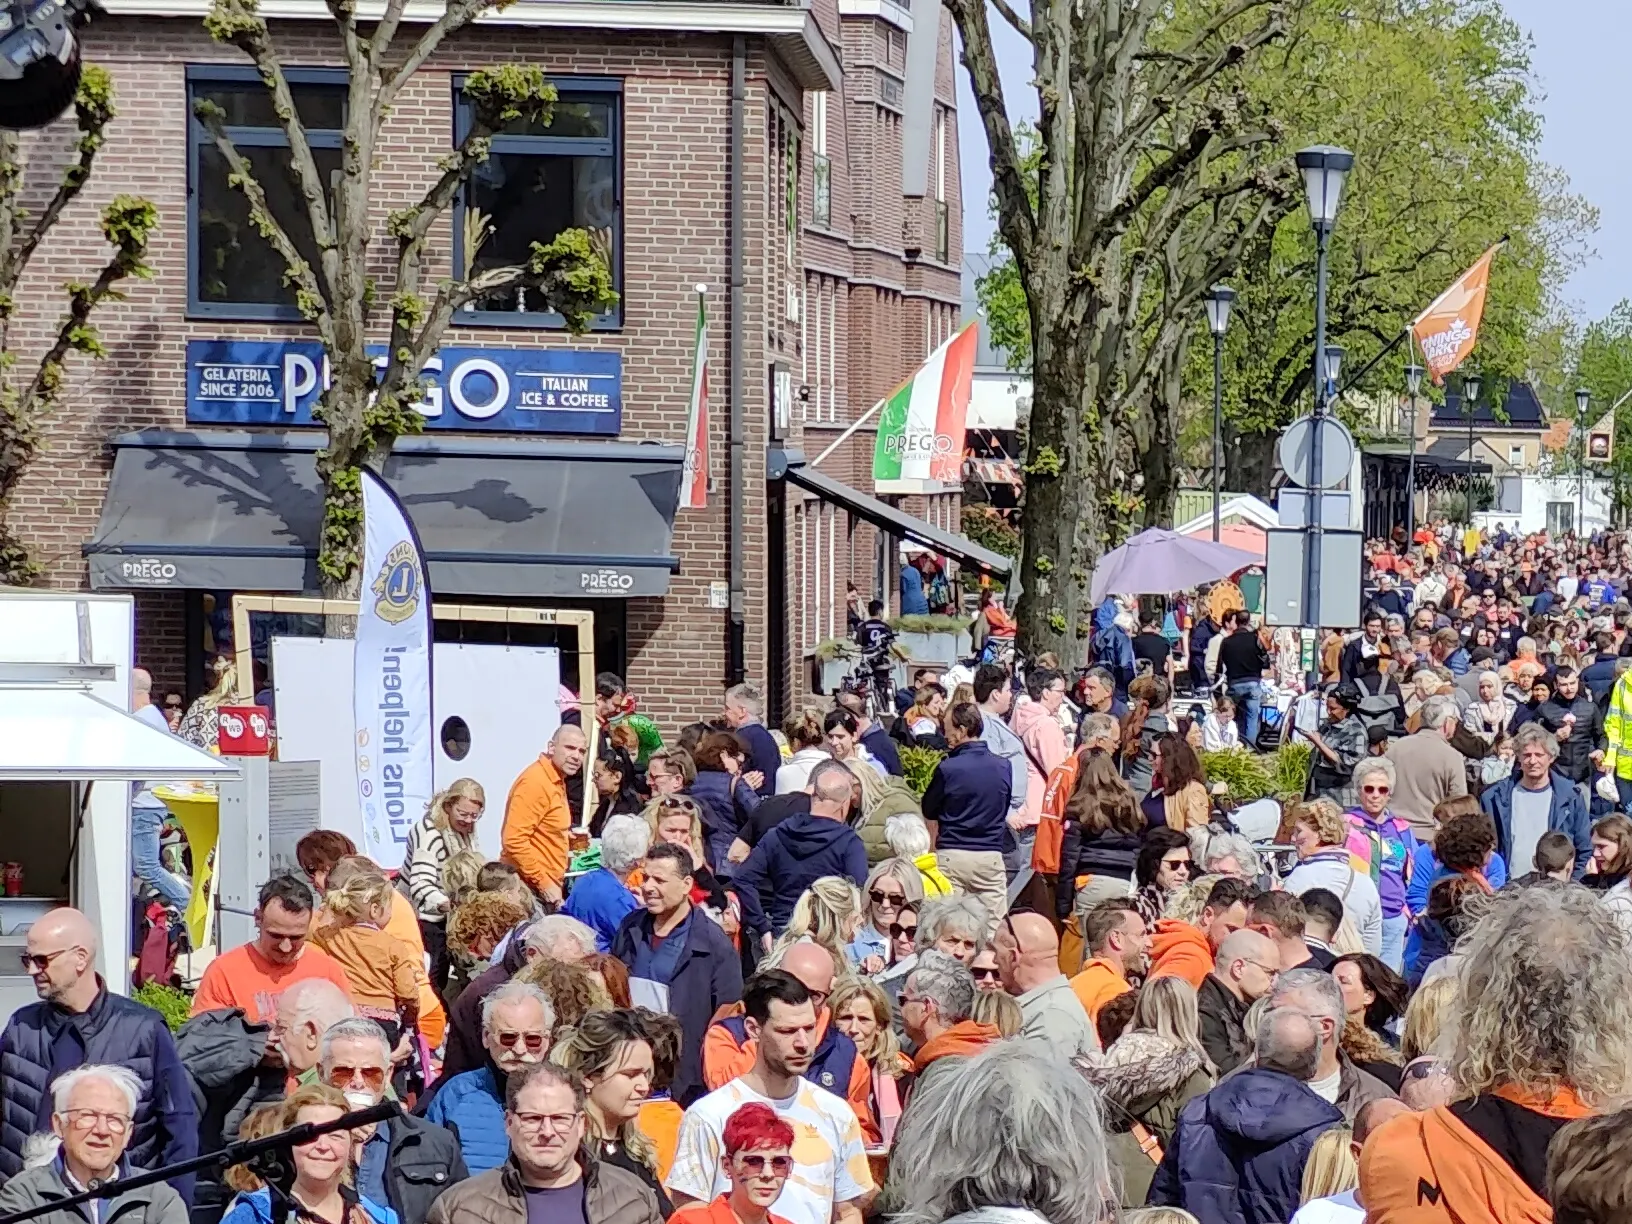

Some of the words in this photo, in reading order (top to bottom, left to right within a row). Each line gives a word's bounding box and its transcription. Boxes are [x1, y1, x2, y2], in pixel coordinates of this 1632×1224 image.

[202, 367, 271, 383] GELATERIA
[200, 383, 238, 397] SINCE
[240, 383, 275, 398] 2006
[542, 377, 589, 392] ITALIAN
[521, 391, 543, 406] ICE
[546, 393, 557, 406] &
[560, 393, 609, 408] COFFEE
[884, 434, 953, 454] PREGO
[122, 563, 177, 578] PREGO
[581, 573, 634, 589] PREGO
